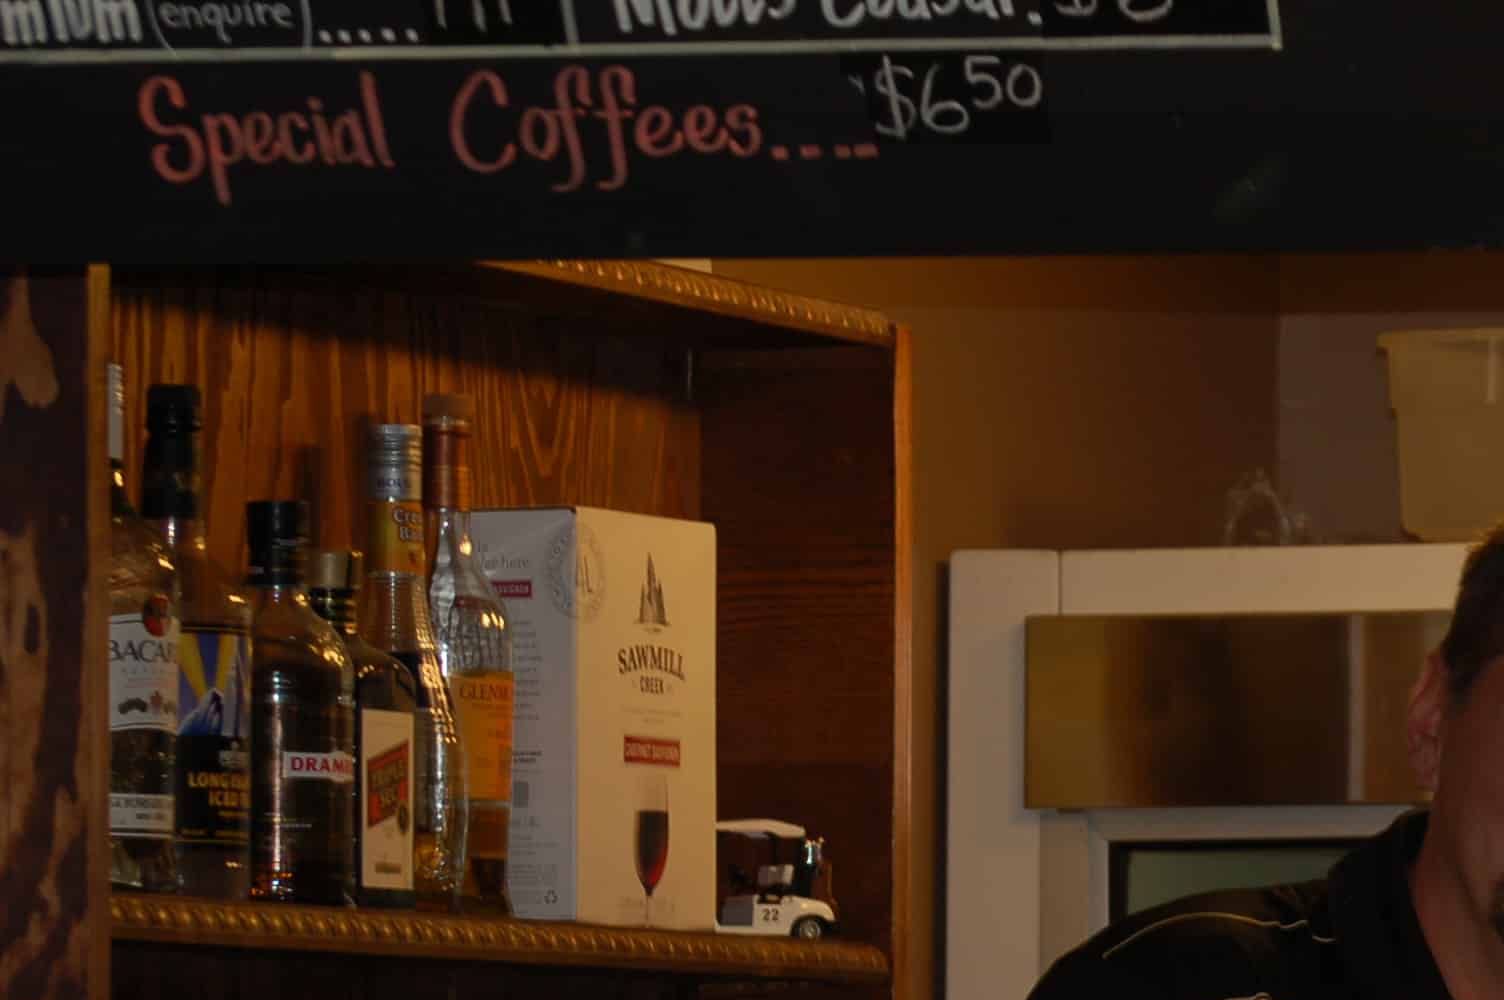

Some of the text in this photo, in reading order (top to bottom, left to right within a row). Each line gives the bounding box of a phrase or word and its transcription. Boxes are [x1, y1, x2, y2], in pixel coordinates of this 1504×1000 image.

[137, 69, 397, 207] Special
[448, 64, 763, 192] Coffees
[617, 644, 687, 682] SAWMILL
[762, 908, 779, 921] 22
